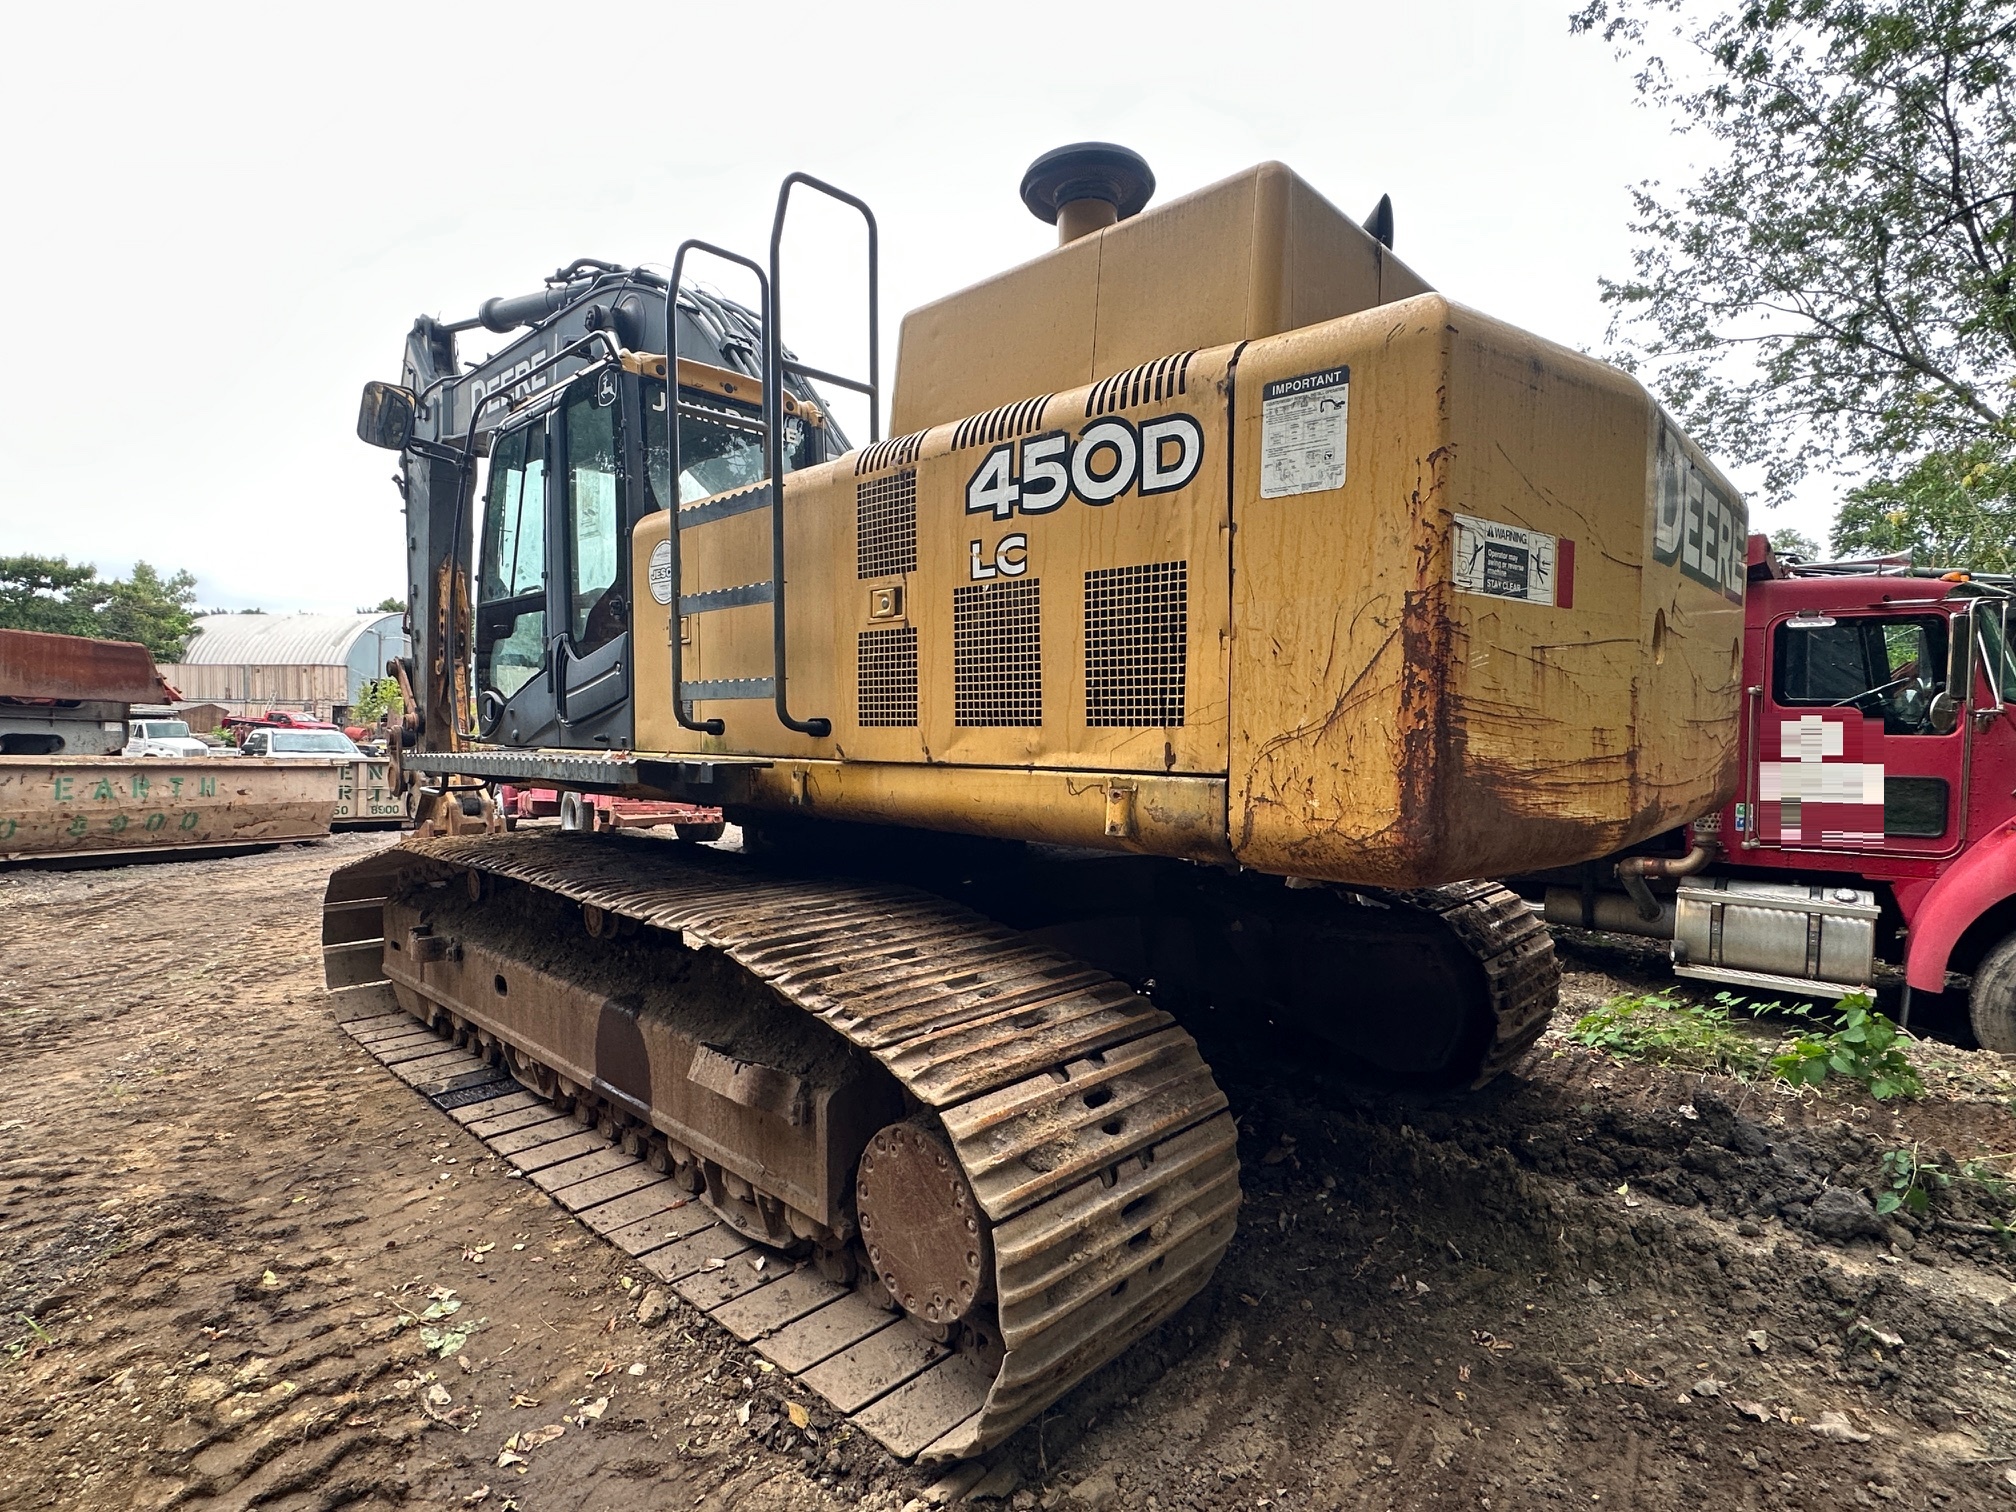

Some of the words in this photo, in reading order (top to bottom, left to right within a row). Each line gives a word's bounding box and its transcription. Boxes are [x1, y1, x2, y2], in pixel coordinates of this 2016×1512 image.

[471, 349, 546, 419] DEERE
[1272, 371, 1342, 396] IMPORTANT
[967, 415, 1203, 519] 450D
[1655, 428, 1745, 598] DEERE
[1495, 527, 1527, 544] WARNING
[971, 534, 1027, 580] LC
[651, 566, 671, 581] JESC
[1487, 579, 1502, 588] STAY
[1503, 582, 1521, 592] CLEAR
[55, 777, 215, 800] EARTH
[370, 804, 400, 815] 8900
